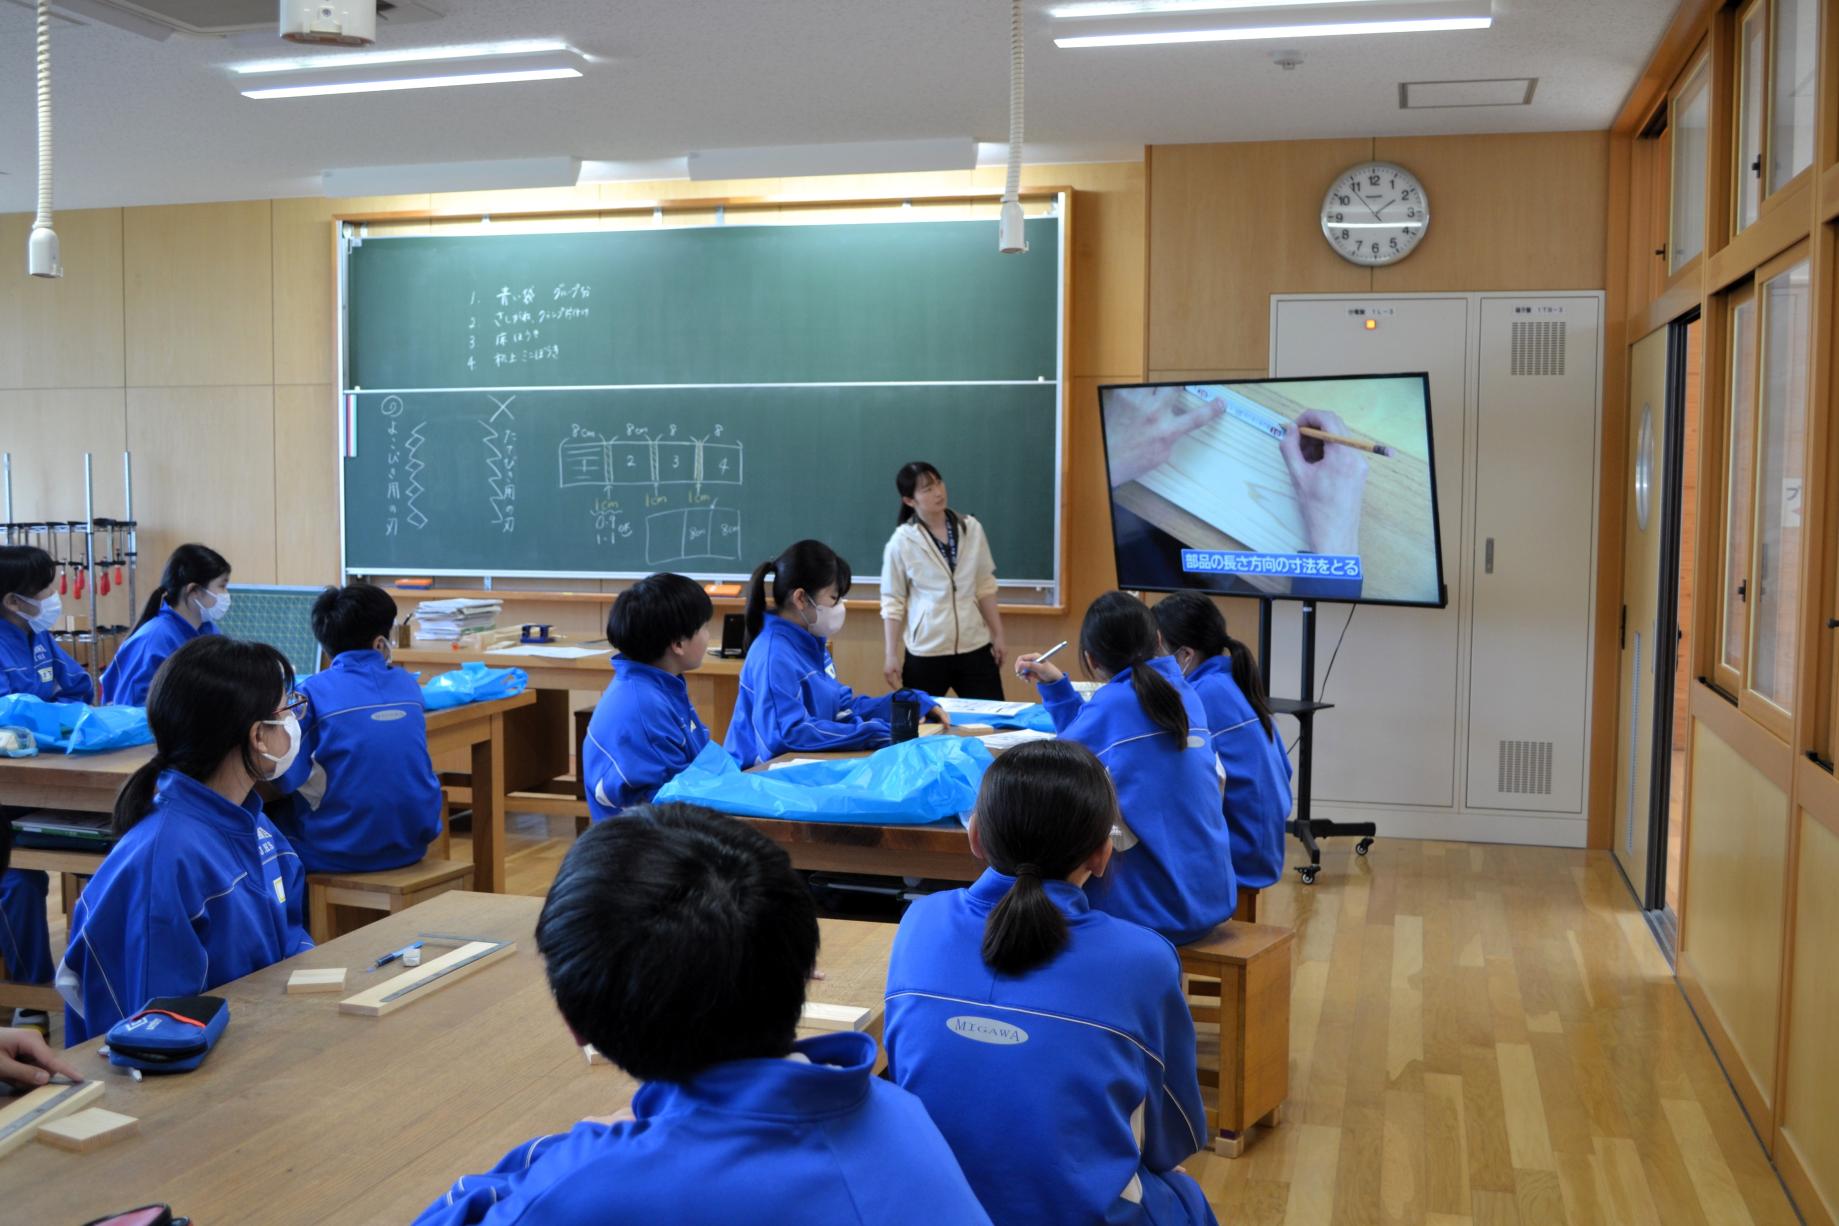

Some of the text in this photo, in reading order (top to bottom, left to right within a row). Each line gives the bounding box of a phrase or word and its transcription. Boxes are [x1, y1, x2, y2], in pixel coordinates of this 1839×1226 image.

[1351, 181, 1361, 192] 11
[1368, 175, 1381, 186] 12
[1389, 179, 1396, 190] 1
[1338, 195, 1350, 206] 10
[1401, 189, 1410, 201] 2
[1335, 213, 1344, 223] 9
[1407, 206, 1415, 218] 3
[1341, 229, 1349, 240] 8
[1402, 226, 1410, 235] 4
[1355, 240, 1363, 251] 7
[1371, 242, 1379, 254] 6
[1389, 237, 1397, 249] 5
[571, 423, 596, 438] 8cm
[625, 422, 648, 437] 8cm
[669, 423, 678, 436] 8
[714, 423, 724, 437] 8
[626, 454, 637, 467] 2
[671, 454, 680, 468] 3
[718, 457, 730, 475] 4
[1185, 553, 1359, 577] 部品の長さ方向の寸法をとる
[954, 1018, 1021, 1042] MIGAWA
